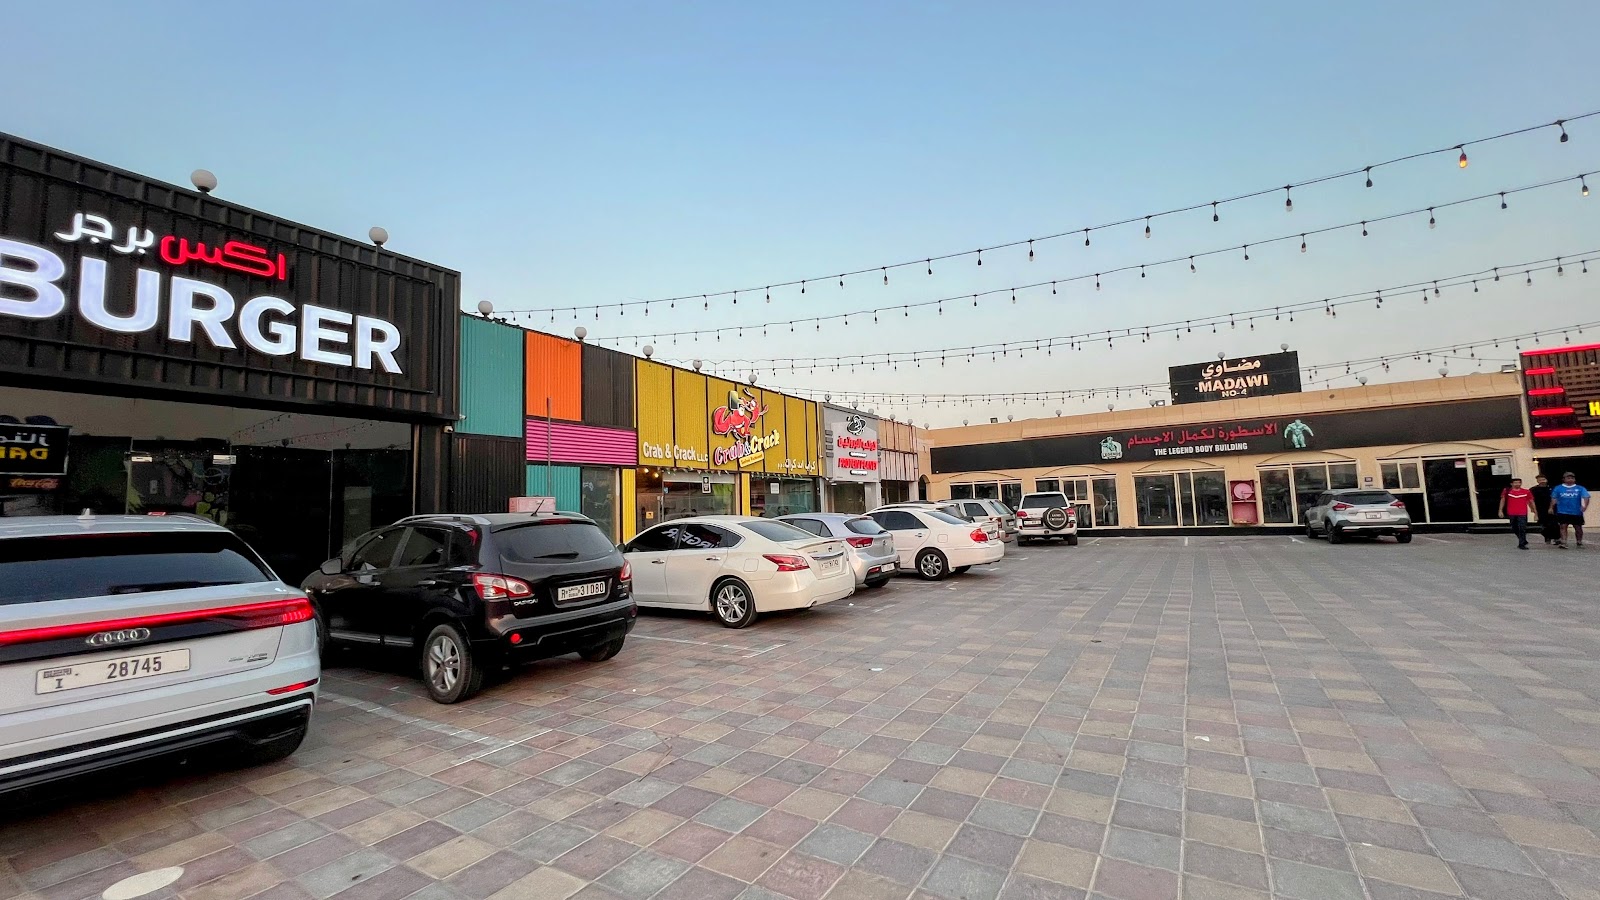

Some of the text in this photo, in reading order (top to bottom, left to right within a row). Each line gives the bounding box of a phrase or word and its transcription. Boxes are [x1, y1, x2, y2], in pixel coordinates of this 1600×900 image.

[54, 211, 286, 281] اكس برجر
[0, 237, 403, 375] BURGER
[1201, 359, 1261, 380] مضاوي
[1198, 373, 1269, 393] MADAWI
[1221, 388, 1248, 398] NO-4
[1127, 422, 1278, 449] الاسطورة لكمال الاجسام
[643, 441, 664, 459] Crab
[665, 443, 672, 459] &
[674, 444, 697, 461] Crack
[1154, 442, 1248, 456] THE LEGEND BODY BUILDING
[107, 656, 163, 680] 28745
[55, 678, 63, 689] I
